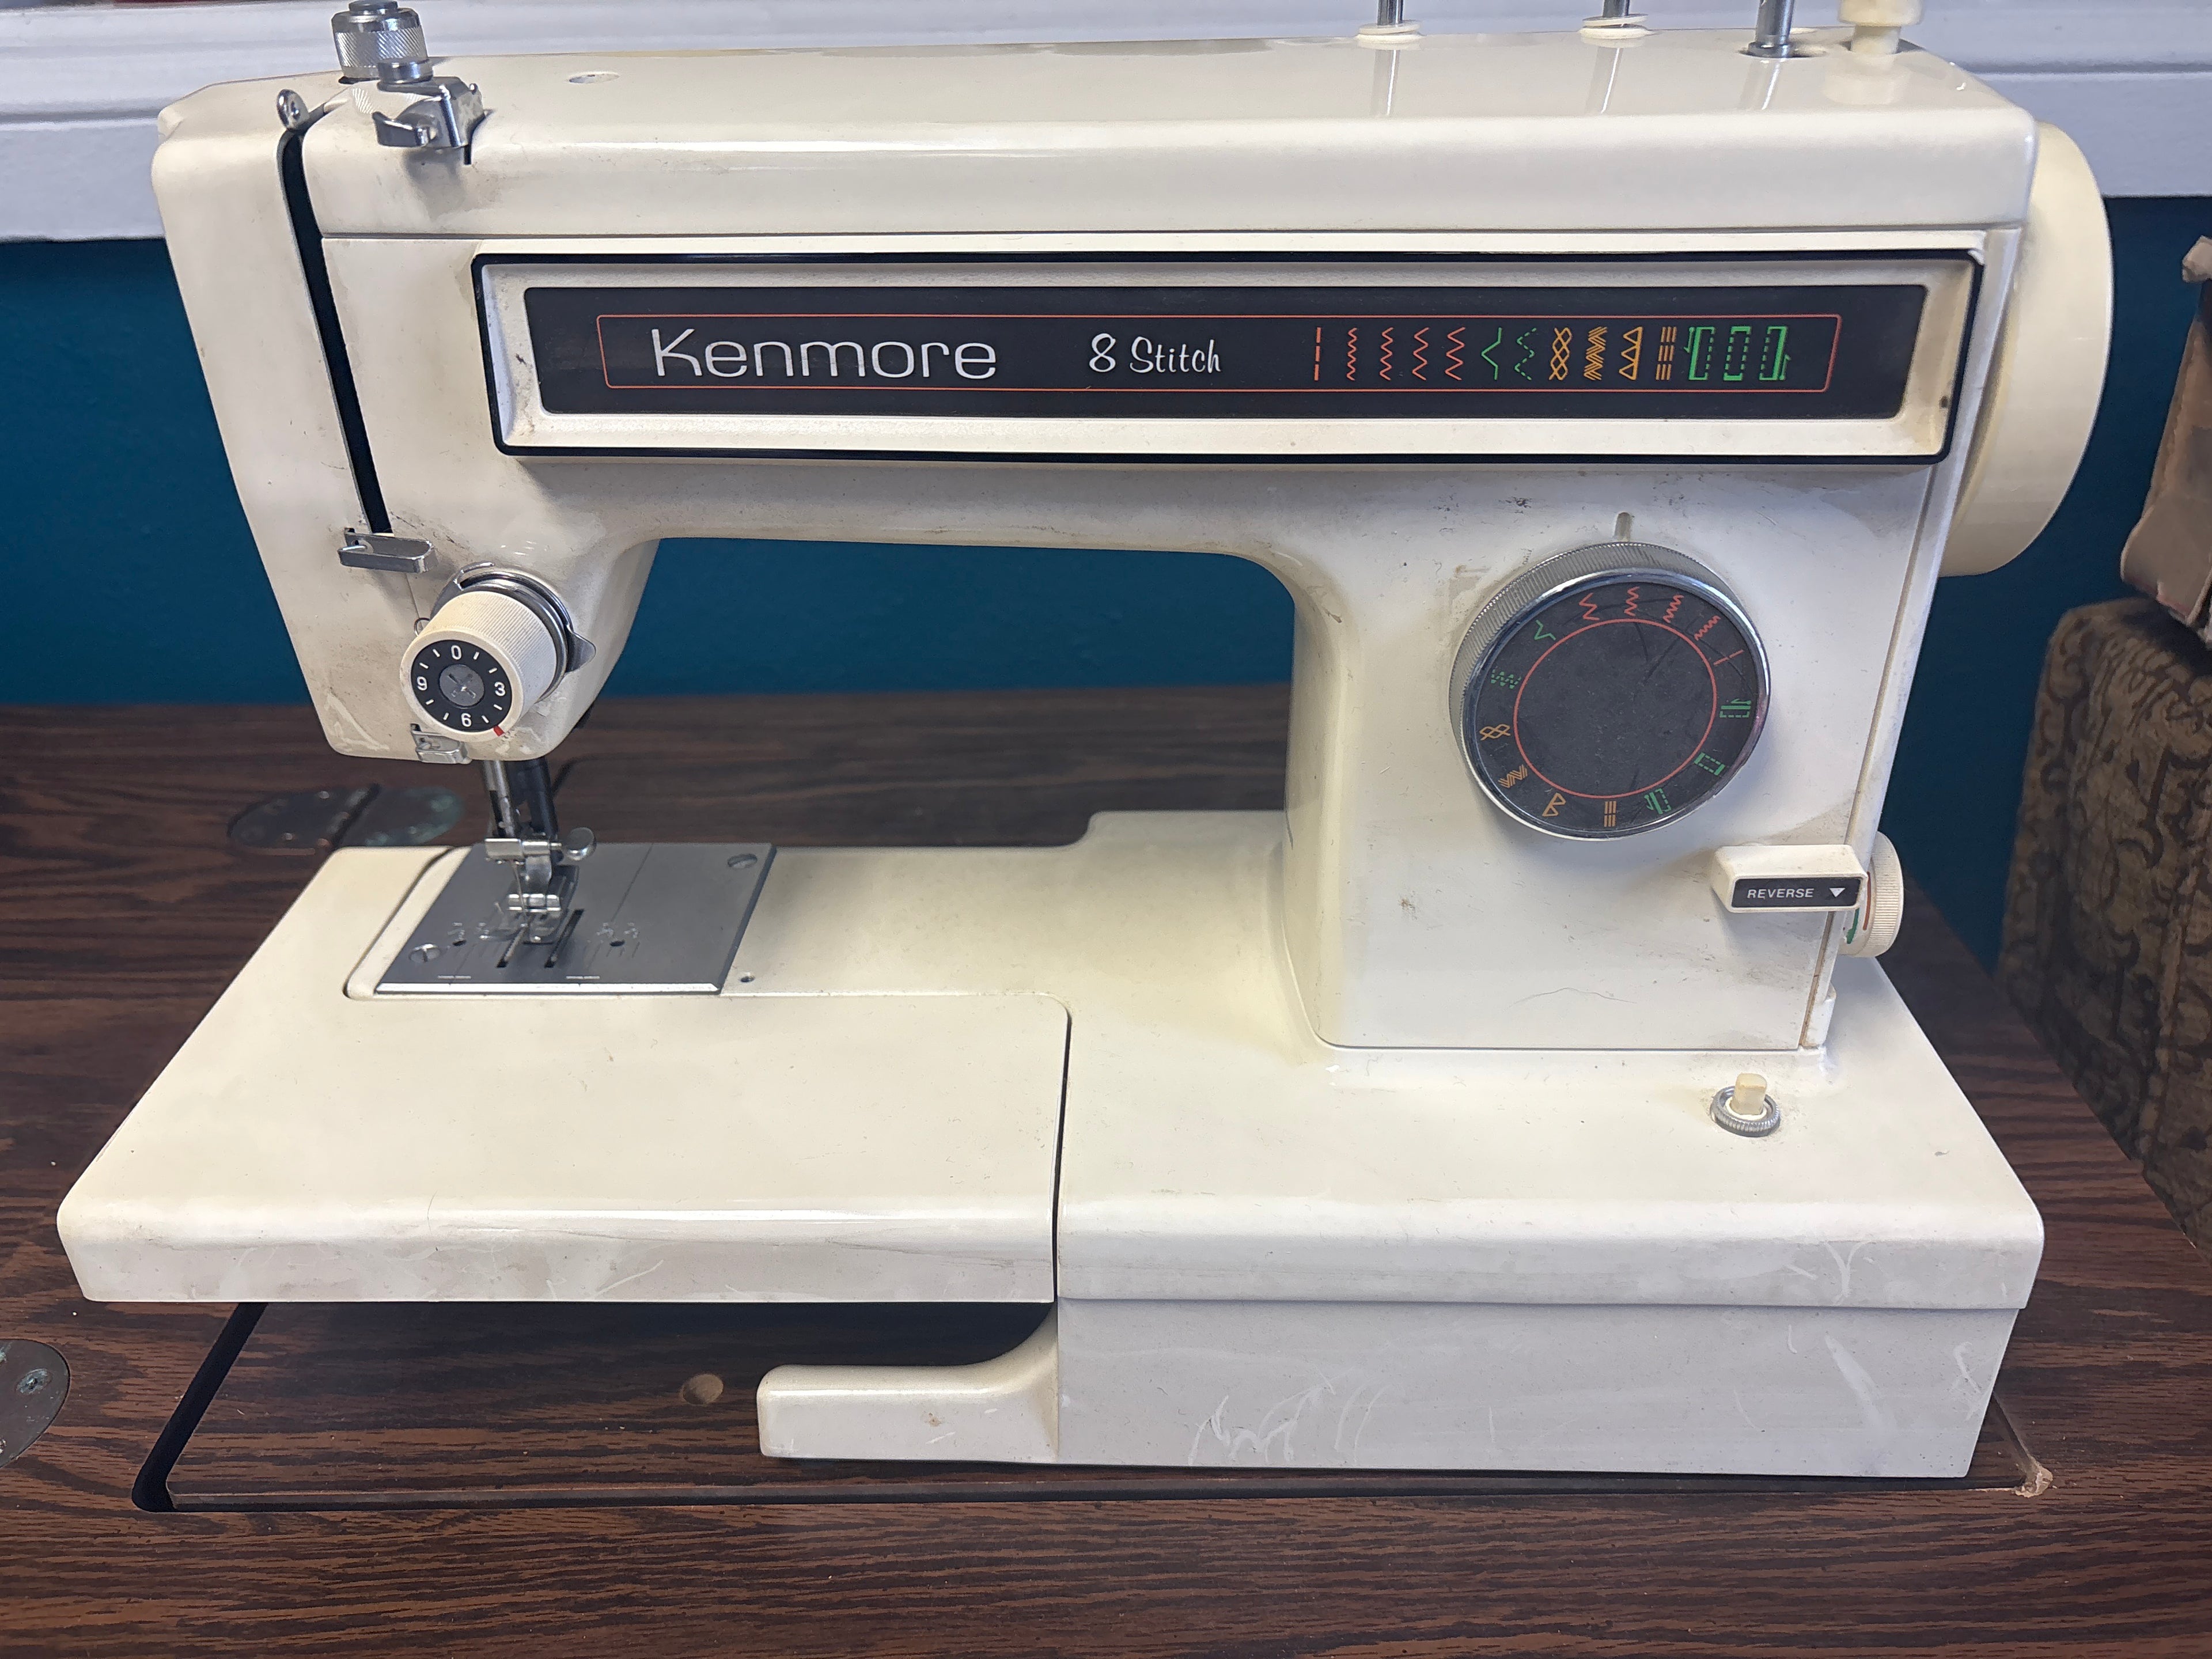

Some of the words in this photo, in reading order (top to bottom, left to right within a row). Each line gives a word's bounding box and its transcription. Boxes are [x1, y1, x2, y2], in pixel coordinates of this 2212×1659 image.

[651, 328, 997, 379] Kenmore
[1088, 332, 1116, 373] 8
[1129, 335, 1222, 374] Stitch
[450, 645, 462, 660] 0
[416, 676, 427, 691] 9
[494, 681, 506, 696] 3
[461, 713, 472, 727] 6
[1746, 888, 1815, 899] REVERSE
